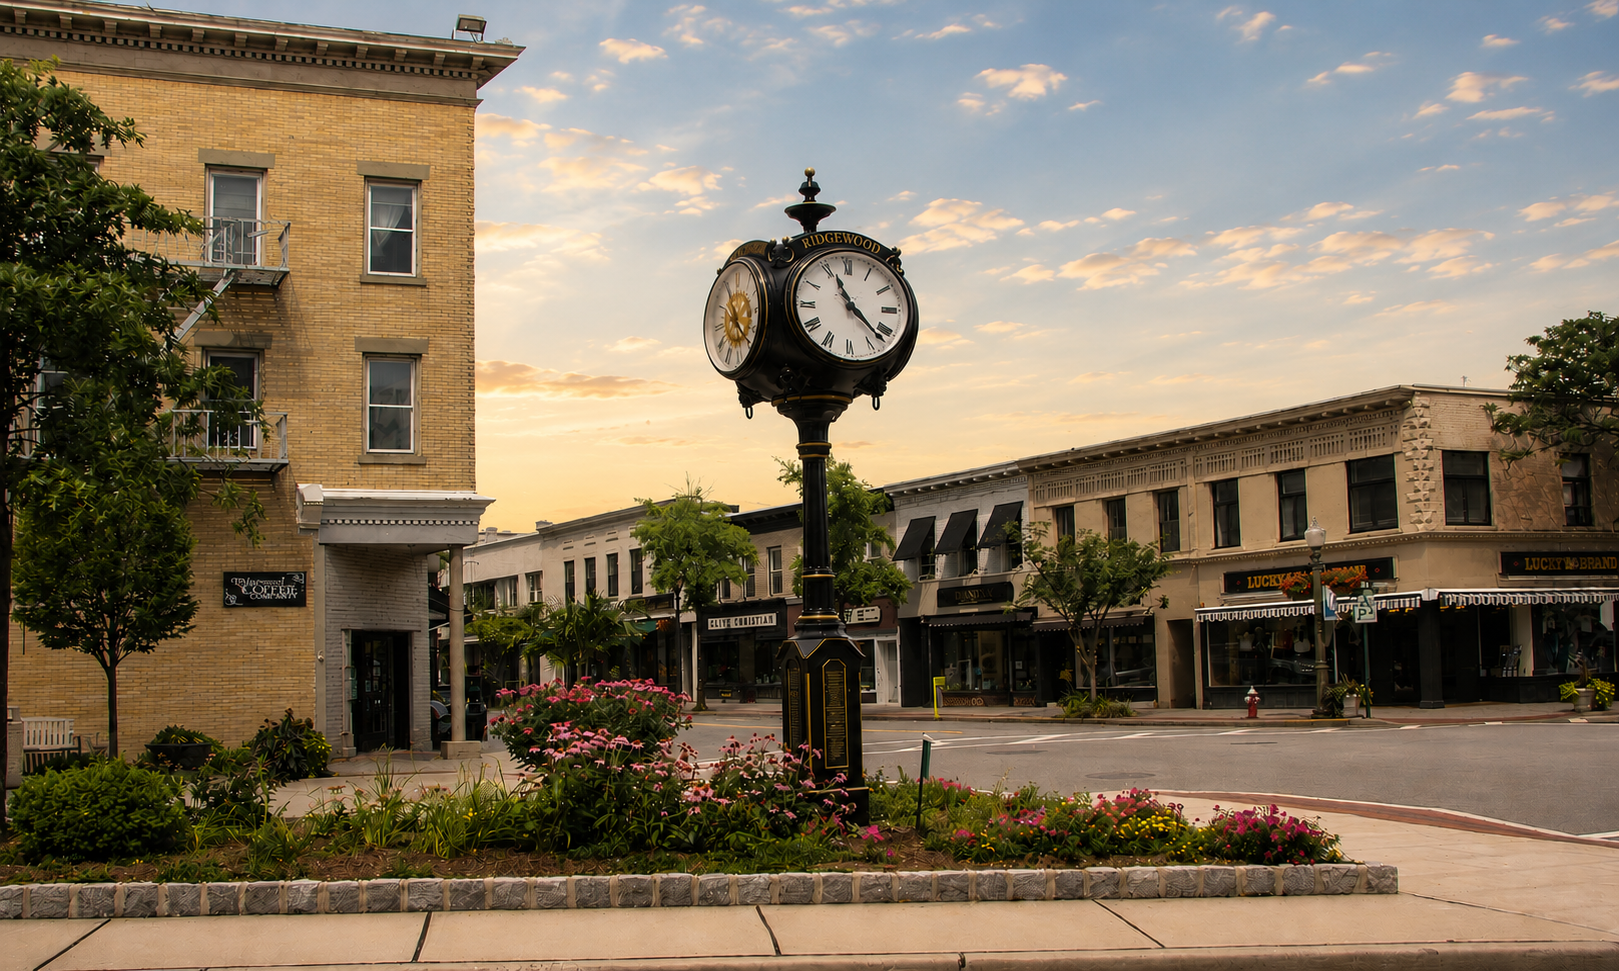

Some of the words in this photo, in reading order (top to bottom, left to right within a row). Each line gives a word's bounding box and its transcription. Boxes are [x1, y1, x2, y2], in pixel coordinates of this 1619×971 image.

[802, 232, 881, 254] RIDGEWOOD
[1524, 557, 1563, 571] LUCKY
[1579, 556, 1618, 570] BRAND
